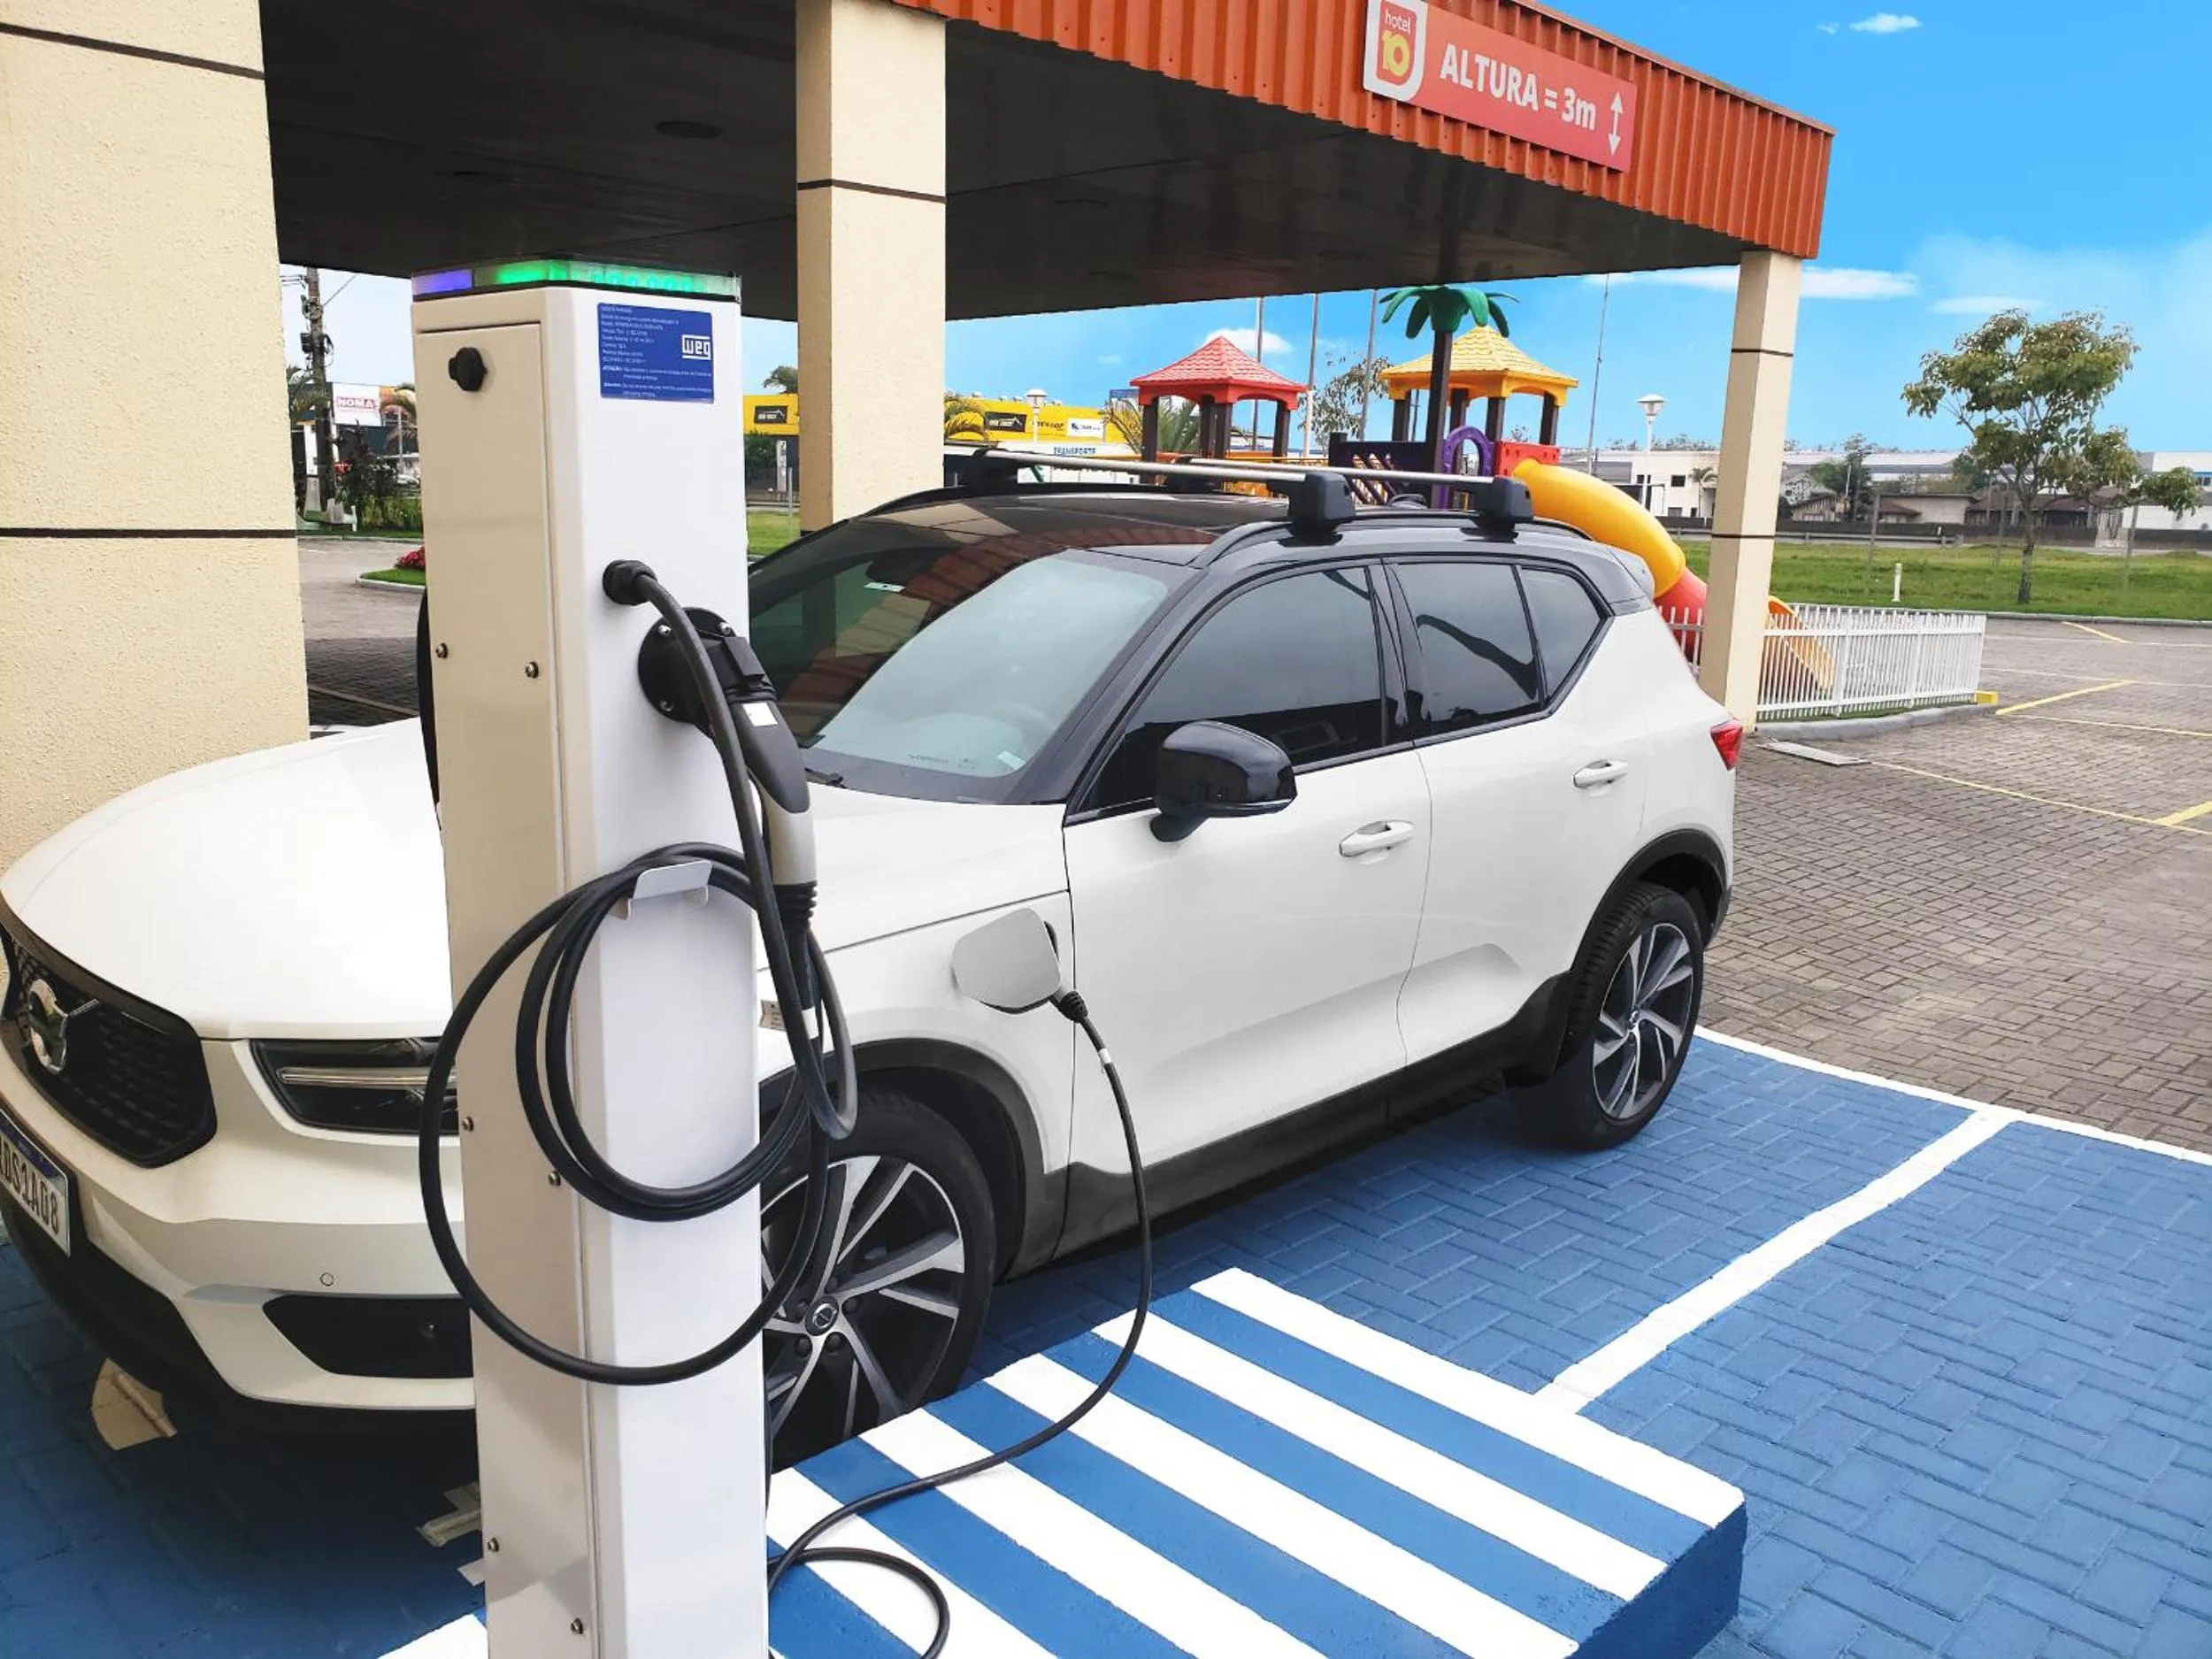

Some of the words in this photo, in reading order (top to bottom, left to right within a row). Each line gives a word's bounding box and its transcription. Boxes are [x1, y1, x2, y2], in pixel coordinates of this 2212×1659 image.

[1384, 12, 1411, 34] hotel
[1382, 30, 1410, 78] 10
[1440, 42, 1539, 112] ALTURA
[1544, 88, 1558, 111] =
[1562, 87, 1596, 131] 3m
